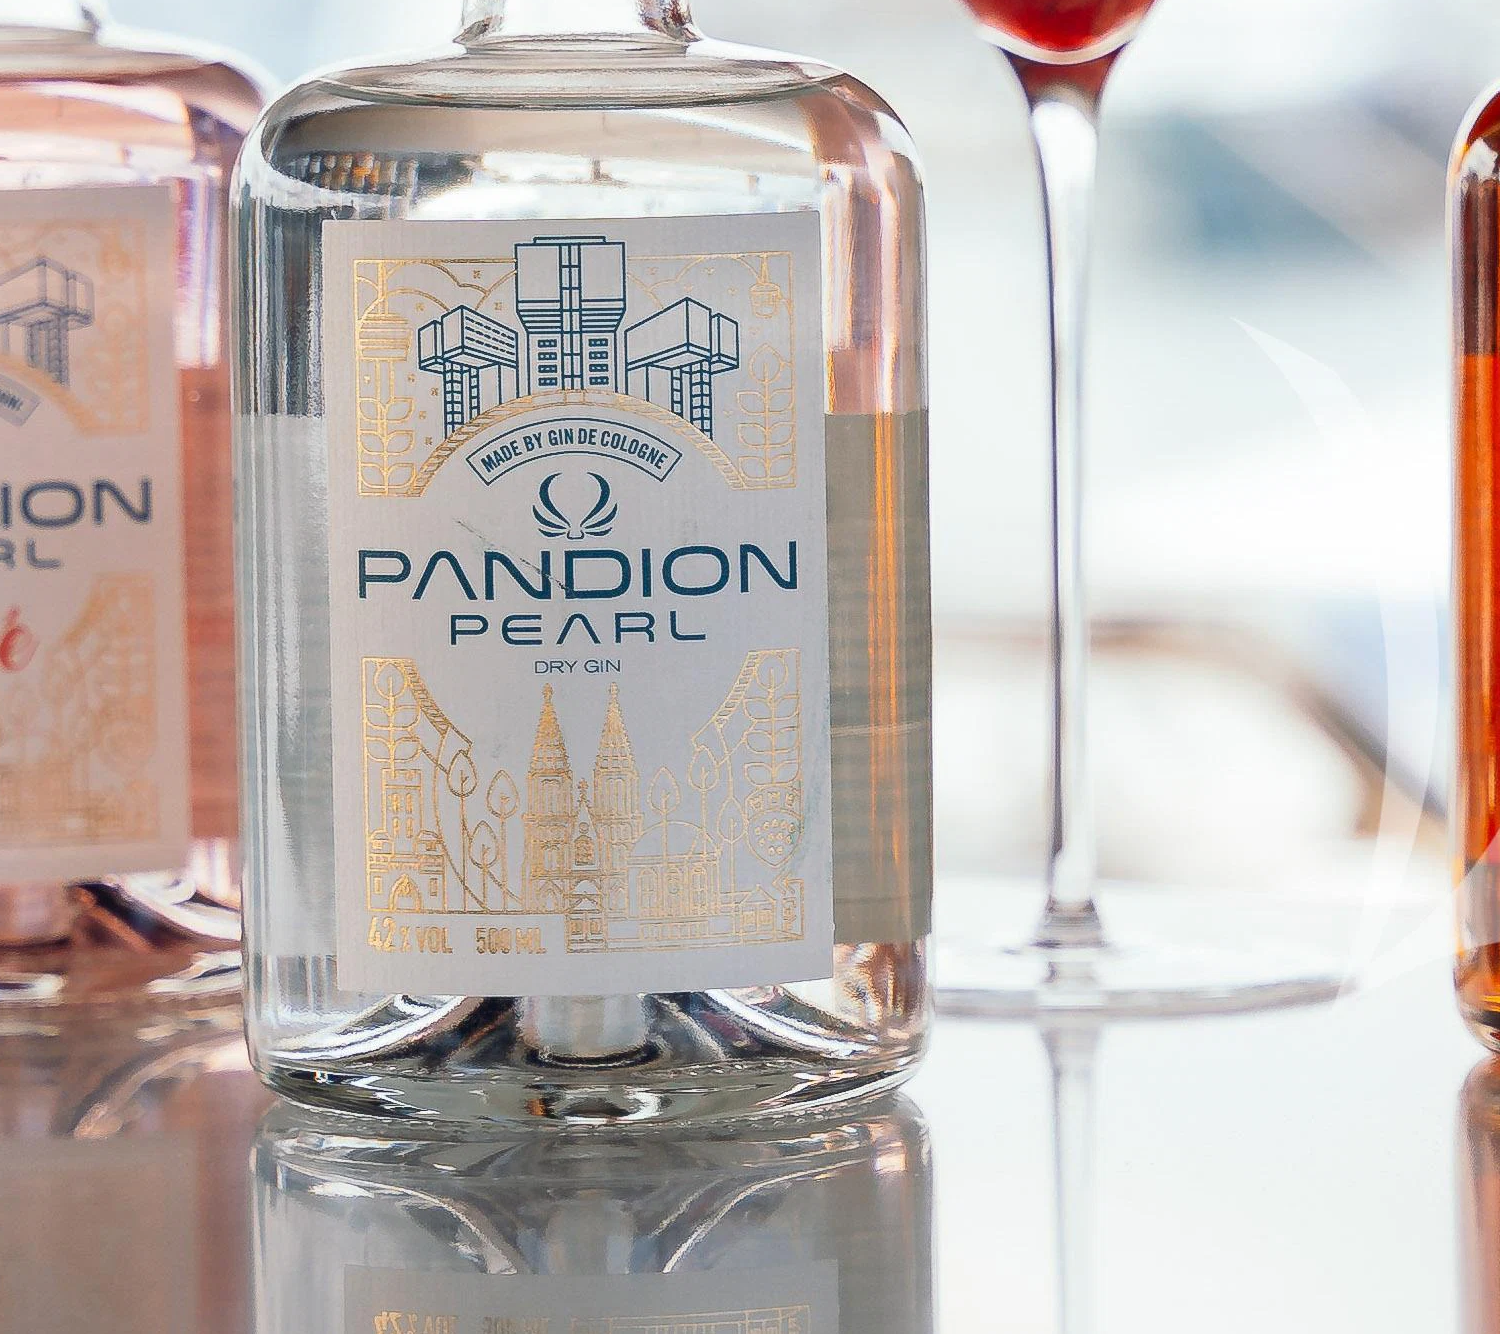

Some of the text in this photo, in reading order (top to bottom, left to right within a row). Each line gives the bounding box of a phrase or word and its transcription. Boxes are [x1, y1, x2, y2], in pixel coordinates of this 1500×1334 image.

[480, 427, 669, 473] MADE BY GIN DE COLOGNE
[358, 541, 797, 601] PANDION
[449, 610, 707, 646] PEARL
[533, 659, 621, 674] DRY GIN
